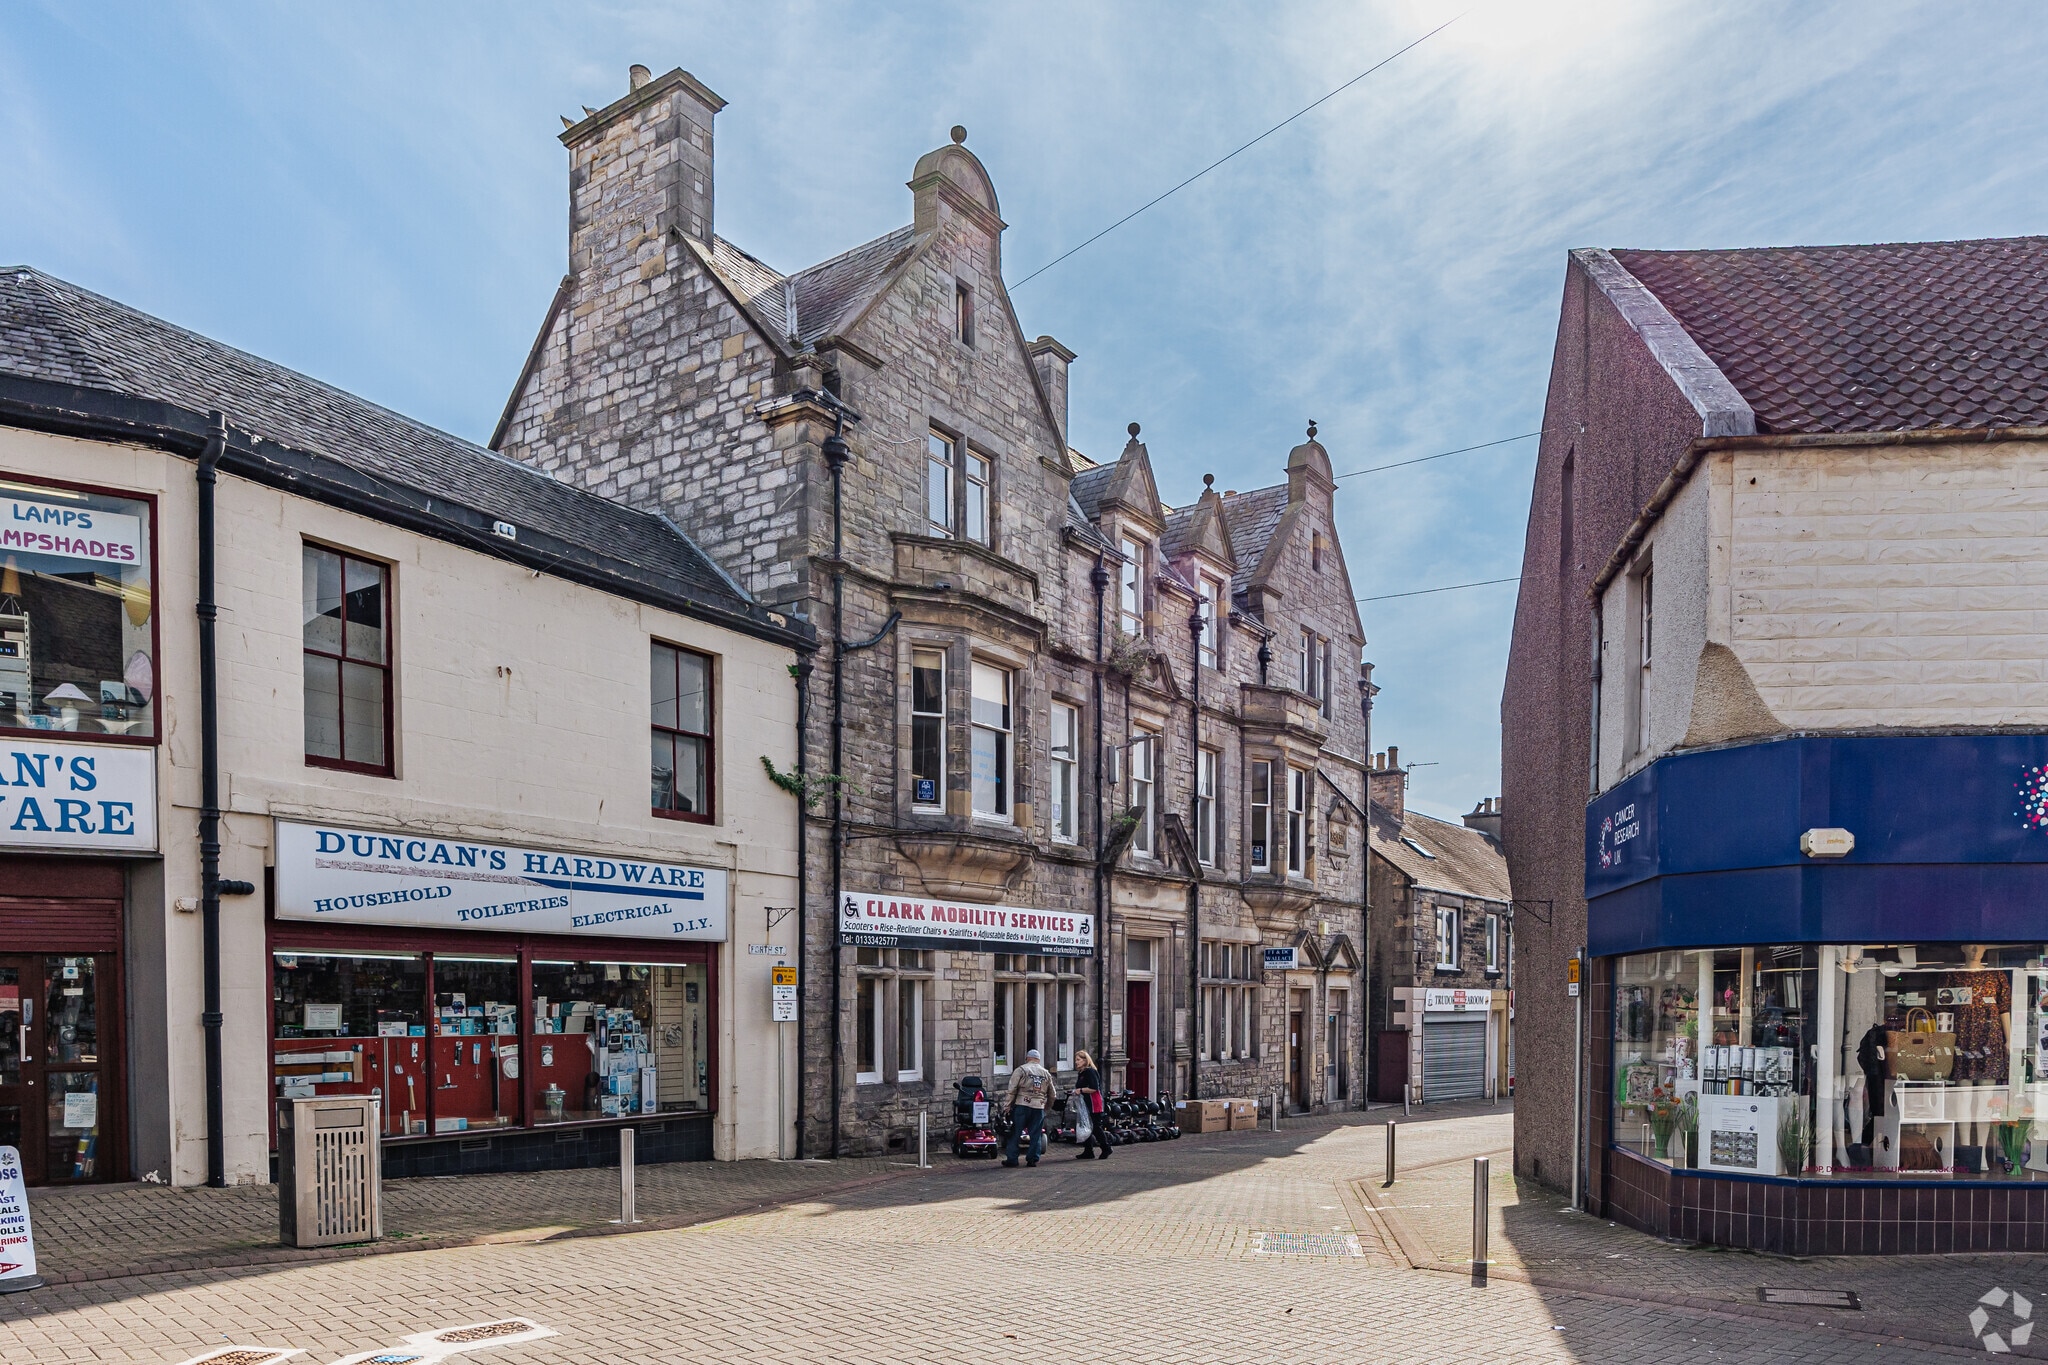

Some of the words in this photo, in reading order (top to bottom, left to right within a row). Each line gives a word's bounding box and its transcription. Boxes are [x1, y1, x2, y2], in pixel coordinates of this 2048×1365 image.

[13, 503, 93, 529] LAMPS
[0, 529, 135, 561] MPSHADES
[0, 752, 97, 791] N'S
[0, 796, 134, 835] ARE
[1614, 803, 1635, 827] CANCER
[1614, 820, 1640, 846] RESEARCH
[315, 830, 507, 871] DUNCAN'S
[523, 853, 705, 889] HARDWARE
[1613, 848, 1622, 865] UK
[313, 885, 452, 913] HOUSEHOLD
[457, 895, 569, 922] TOILETRIES
[571, 903, 673, 928] ELECTRICAL
[673, 918, 713, 934] D.I.Y.
[866, 899, 926, 921] CLARK
[931, 905, 1007, 927] MOBILITY
[1011, 913, 1074, 933] SERVICES
[842, 933, 854, 944] Tel:
[855, 935, 898, 946] 01333425777
[844, 920, 874, 931] Scooters
[879, 923, 922, 934] Rise-Recliner
[922, 925, 942, 936] Chairs
[948, 927, 973, 938] Stairlifts
[978, 930, 1006, 940] Adjustable
[1006, 932, 1020, 941] Beds
[1025, 933, 1040, 944] Living
[1041, 934, 1052, 943] Aids
[1056, 936, 1075, 945] Repairs
[1080, 937, 1089, 945] Hire
[751, 945, 772, 954] FORTH
[1042, 946, 1092, 956] www.clarkmobility.co.uk
[0, 1215, 25, 1224] KING
